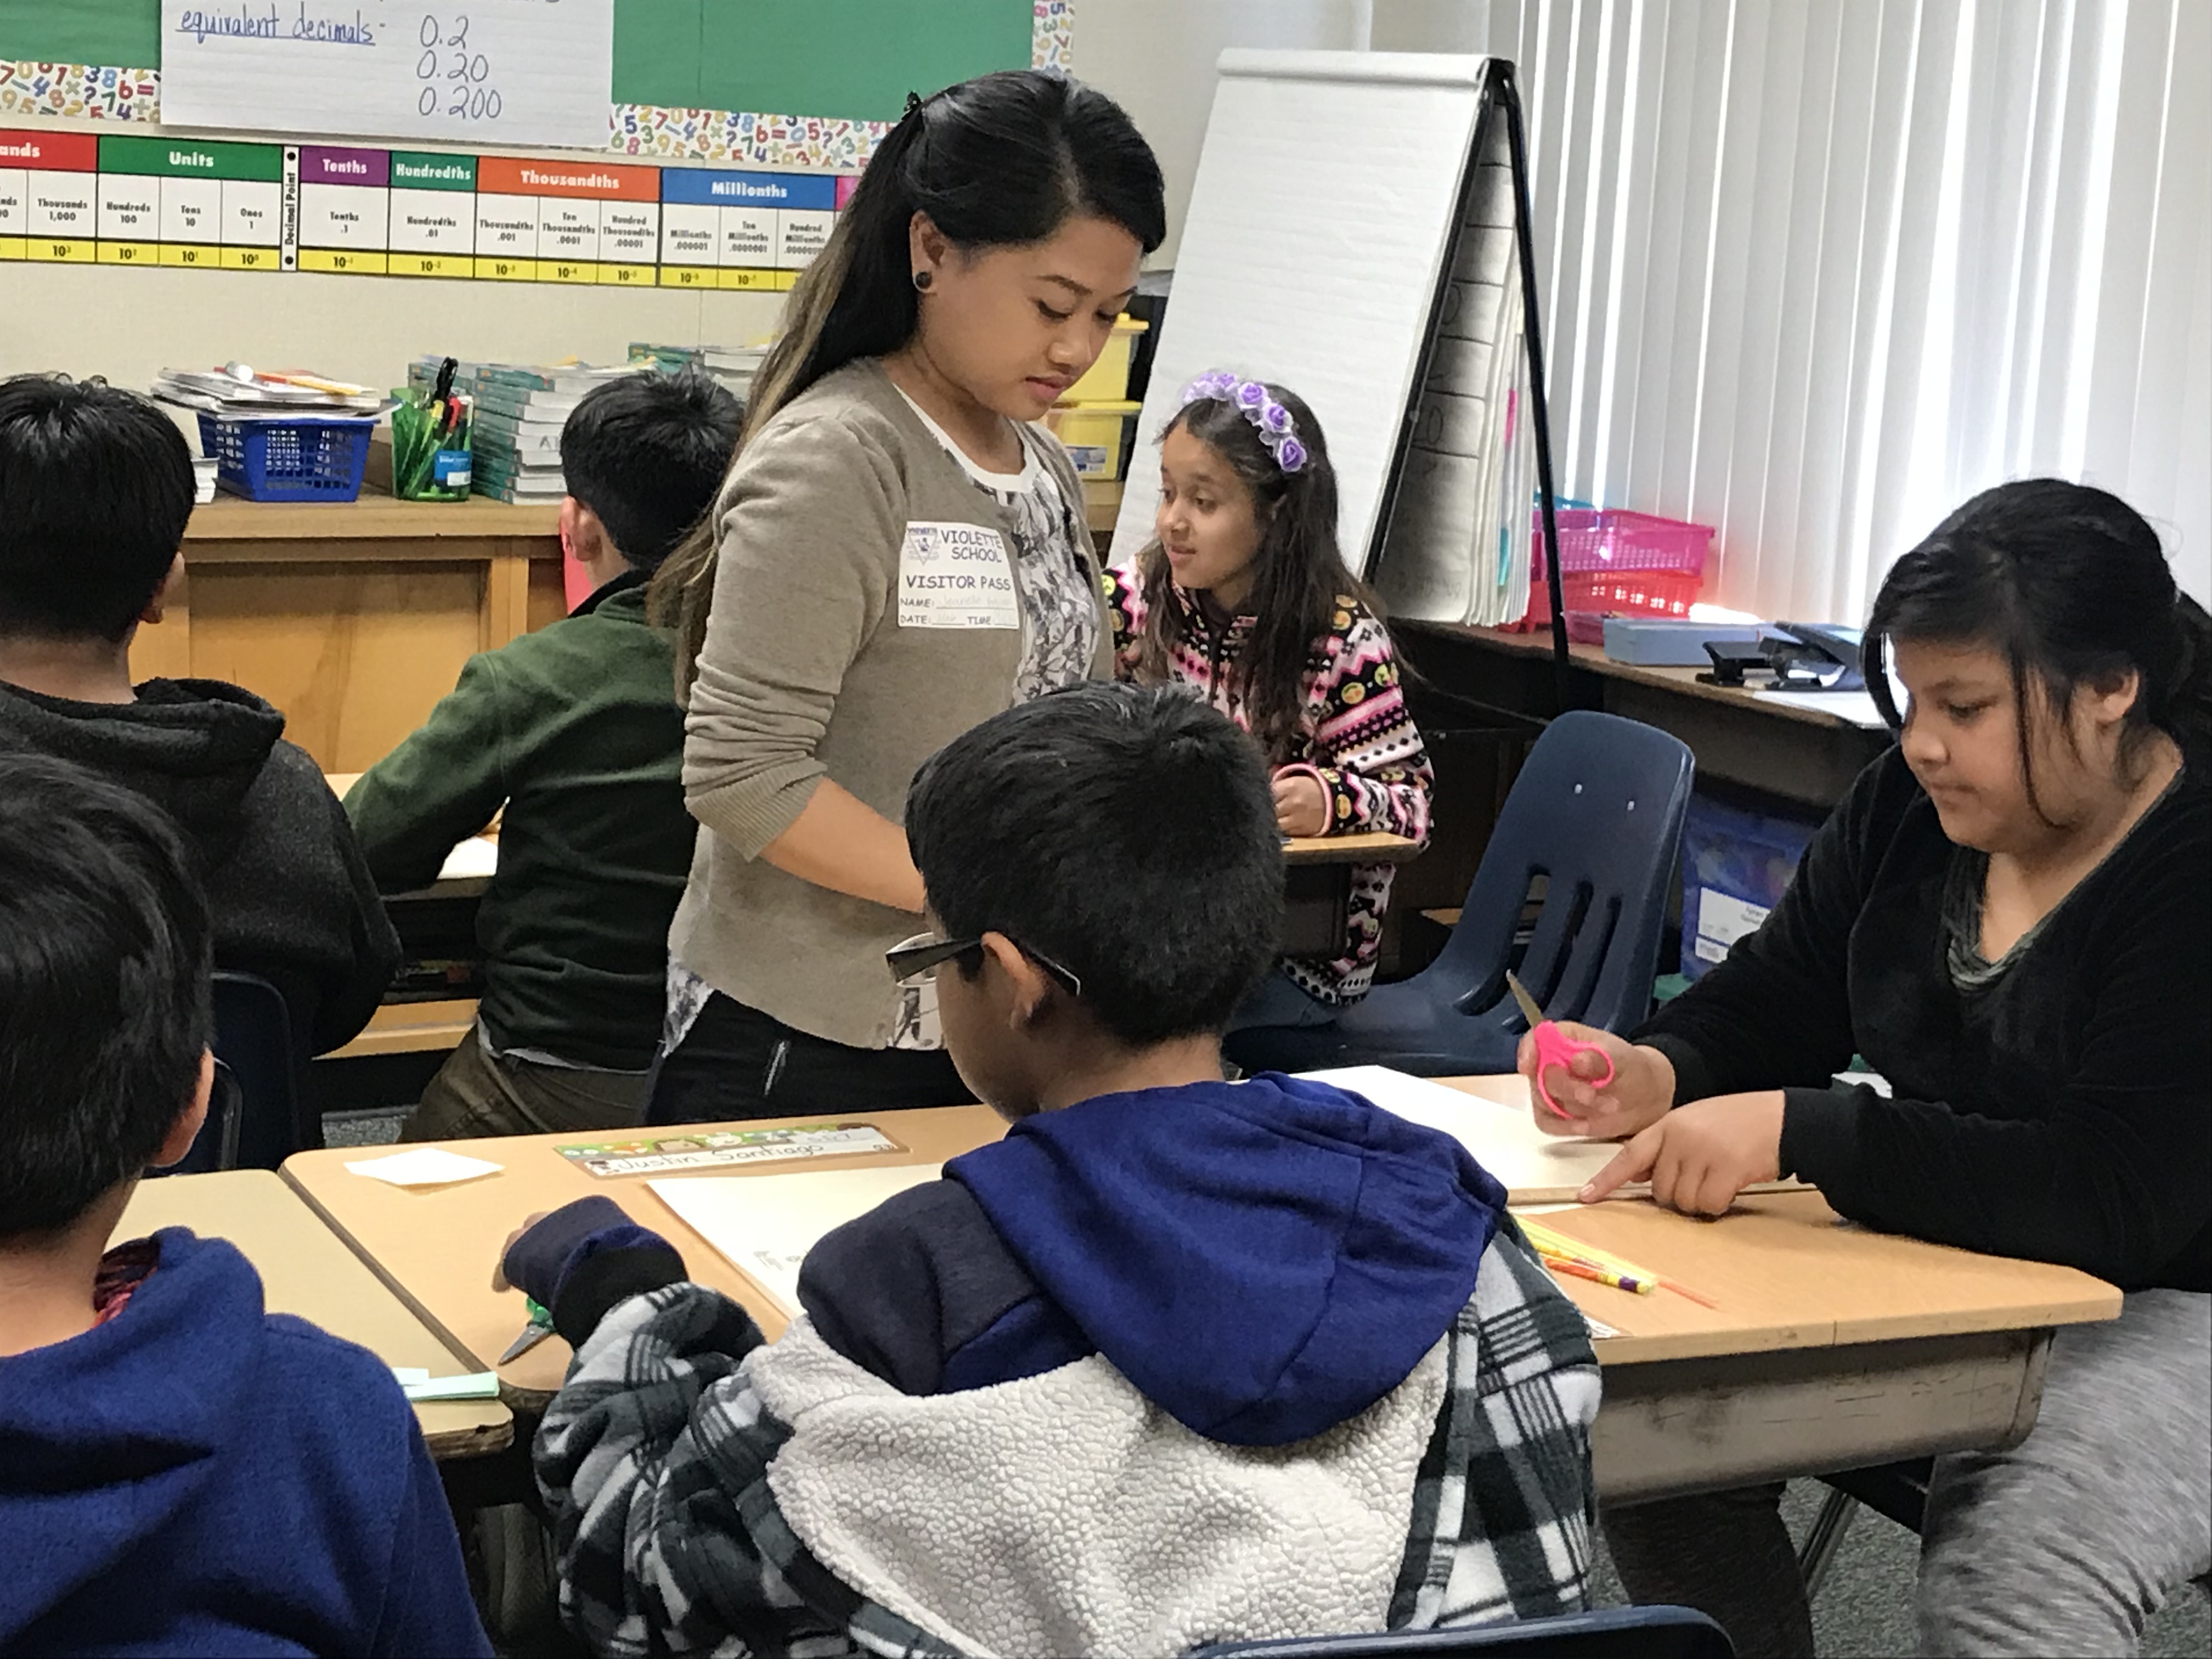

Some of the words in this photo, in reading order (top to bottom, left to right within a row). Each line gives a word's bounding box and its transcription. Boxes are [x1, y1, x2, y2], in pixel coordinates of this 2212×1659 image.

[180, 3, 280, 44] equivalent
[420, 14, 470, 49] 0.2
[416, 49, 489, 83] 0.20
[418, 85, 502, 120] 0.200
[169, 151, 214, 167] Units
[323, 159, 367, 174] Tenths
[396, 163, 471, 180] Hundredths
[521, 170, 620, 189] Thousandths
[286, 172, 296, 201] Point
[712, 182, 787, 198] Millionths
[38, 199, 88, 209] Thousands
[106, 201, 151, 212] Hundreds
[181, 205, 201, 215] Tens
[49, 211, 76, 221] 1,000
[120, 215, 137, 224] 100
[240, 208, 263, 218] Ones
[330, 212, 359, 222] Tenths
[562, 212, 577, 221] Ten
[185, 218, 196, 227] 10
[249, 221, 253, 229] 1
[285, 204, 295, 245] Decimal
[407, 216, 457, 227] Hundredths
[479, 219, 534, 230] Thousandths
[612, 216, 647, 225] Hundred
[543, 223, 595, 234] Thousandths
[603, 227, 654, 237] Thousandths
[941, 531, 1003, 549] VIOLETTE
[952, 547, 1002, 562] SCHOOL
[906, 575, 976, 589] VISITOR
[981, 576, 1011, 590] PASS
[618, 1155, 699, 1169] Justin
[712, 1145, 823, 1161] Santiago
